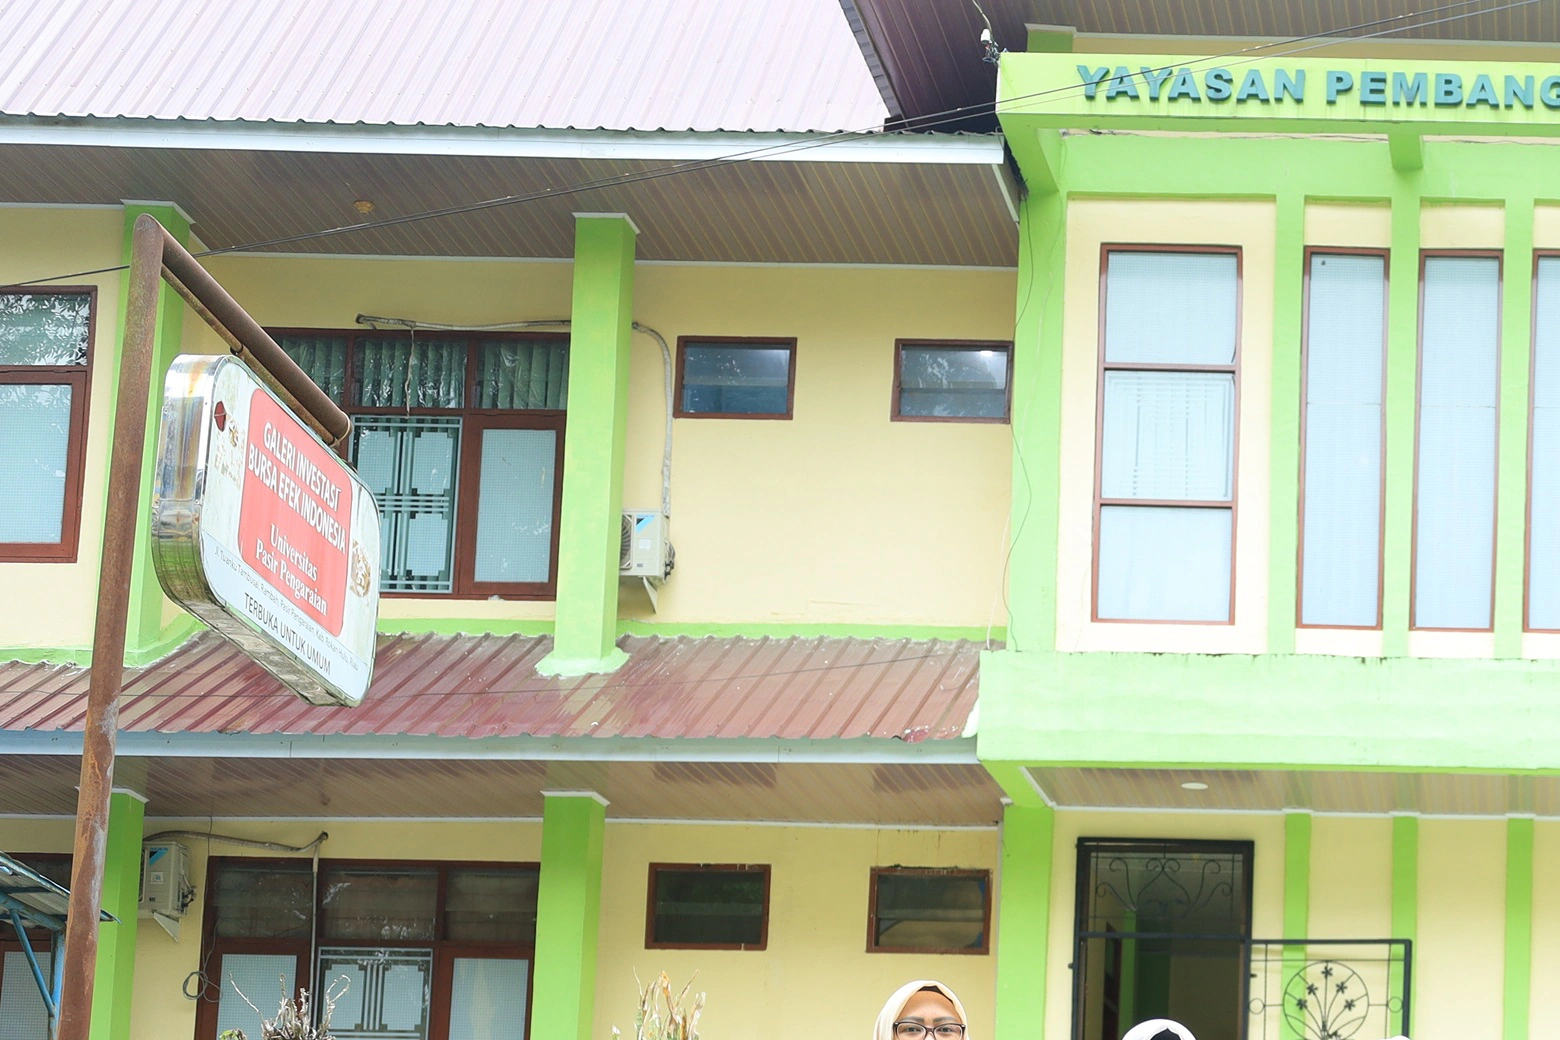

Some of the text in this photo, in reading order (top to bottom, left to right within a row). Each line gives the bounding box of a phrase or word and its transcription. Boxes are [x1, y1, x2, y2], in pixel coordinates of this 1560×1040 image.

[1077, 64, 1306, 104] YAYASAN
[248, 442, 278, 494] BURSA
[279, 470, 301, 515] EFEK
[301, 491, 346, 555] INDONESIA
[264, 419, 295, 472] GALERI
[296, 450, 339, 513] INVESTASI
[256, 537, 327, 617] Pasir Pengaraian
[270, 523, 318, 584] Universitas
[244, 592, 331, 676] TERBUKA UNTUK UMUM
